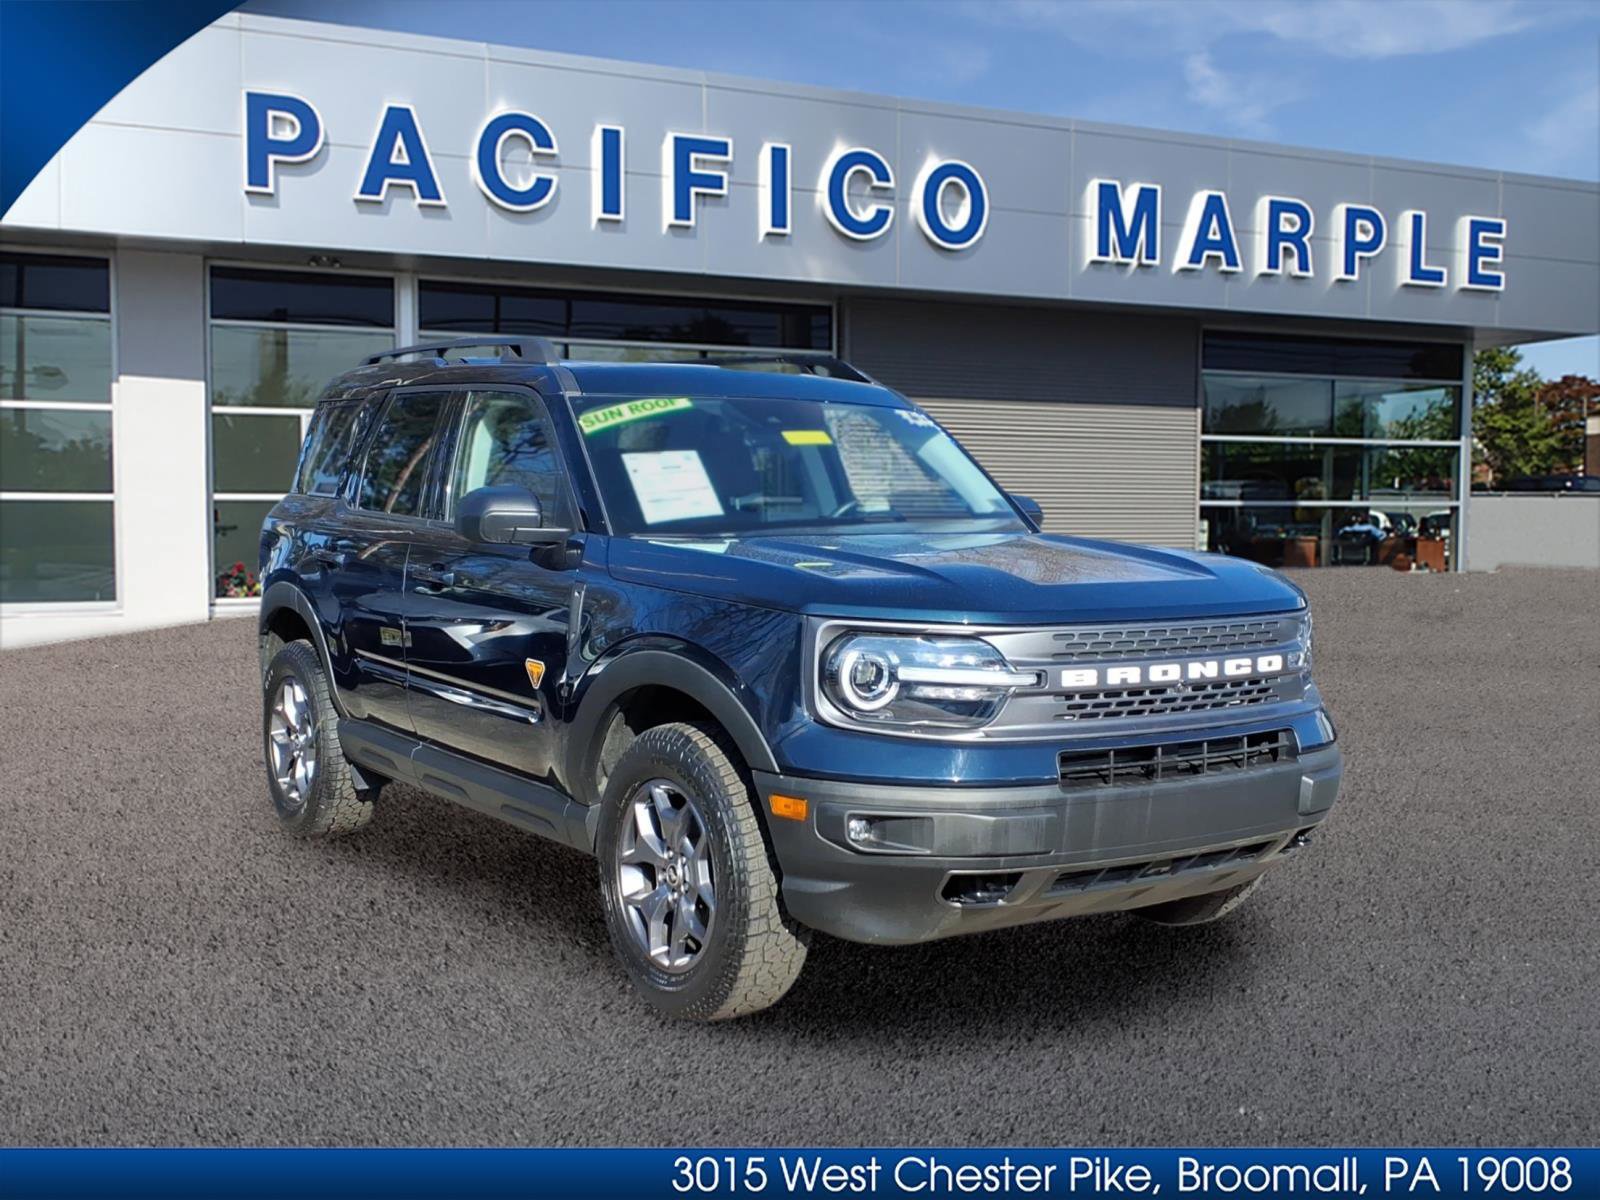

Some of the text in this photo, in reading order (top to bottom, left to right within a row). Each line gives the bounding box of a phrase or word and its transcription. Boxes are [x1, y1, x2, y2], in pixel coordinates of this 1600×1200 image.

[243, 88, 1507, 291] PACIFICO MARPLE
[581, 409, 623, 429] SUN
[1061, 654, 1283, 688] BRONCO
